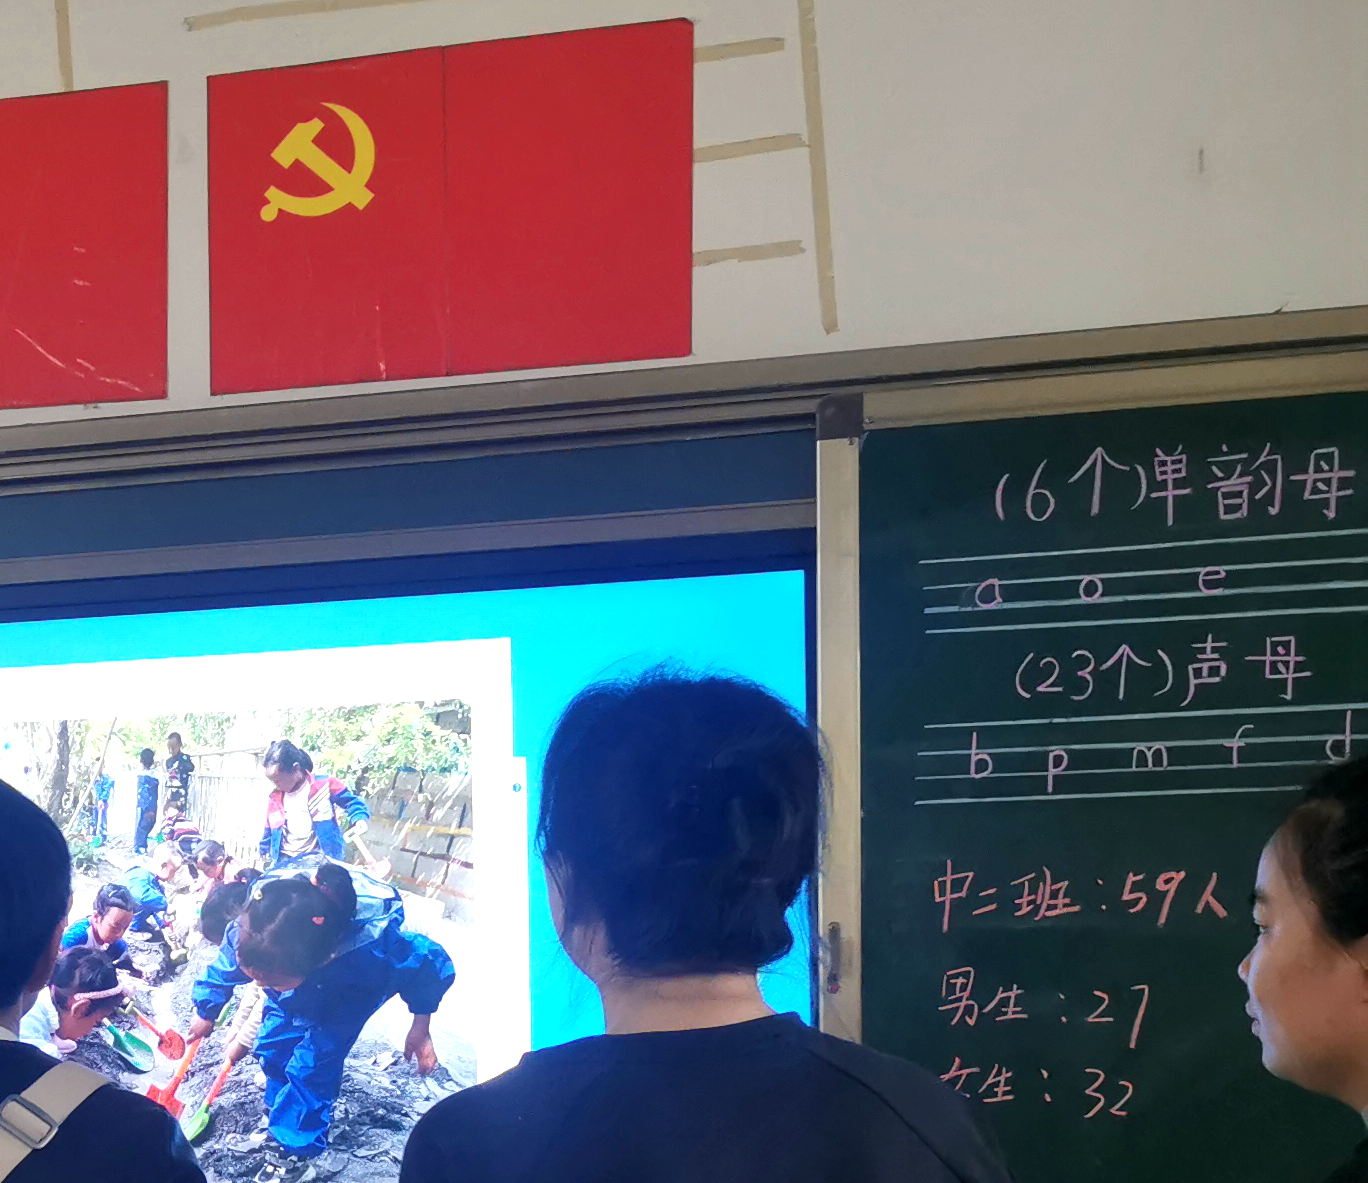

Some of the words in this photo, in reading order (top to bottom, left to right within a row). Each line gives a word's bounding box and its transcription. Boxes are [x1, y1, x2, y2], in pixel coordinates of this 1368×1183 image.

[975, 578, 1003, 607] a
[1078, 575, 1104, 601] o
[1198, 567, 1226, 594] e
[970, 731, 993, 778] b
[1047, 749, 1068, 793] p
[1132, 745, 1167, 770] m
[1224, 724, 1254, 767] f
[1326, 710, 1352, 762] d
